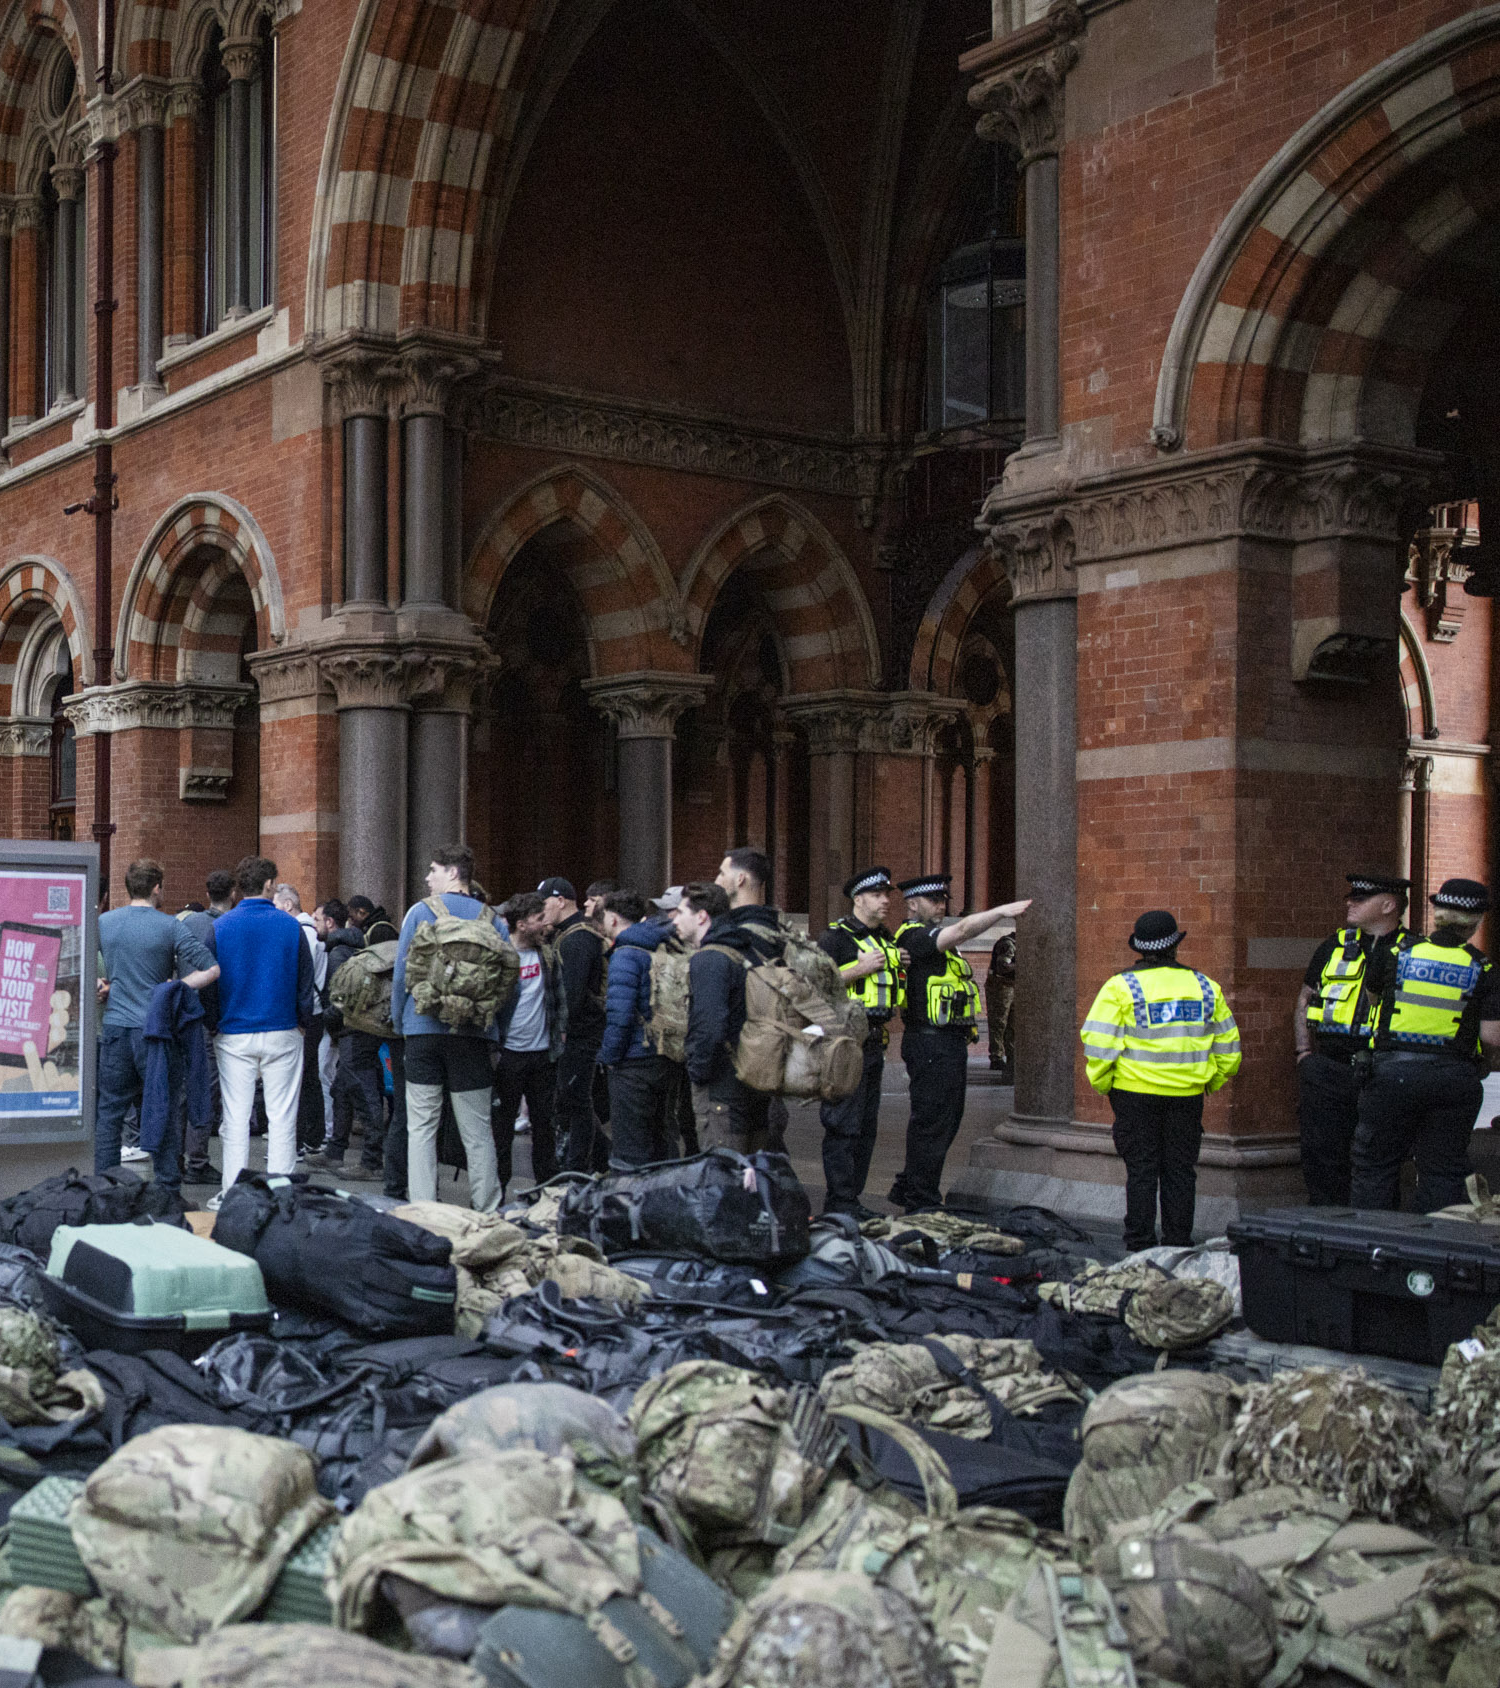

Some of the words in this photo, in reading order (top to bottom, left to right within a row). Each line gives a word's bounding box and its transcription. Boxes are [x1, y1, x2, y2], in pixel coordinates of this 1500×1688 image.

[5, 938, 36, 961] HOW
[2, 958, 31, 980] WAS
[1404, 965, 1469, 986] POLICE
[0, 977, 35, 1001] YOUR
[1151, 1008, 1200, 1022] POLICE
